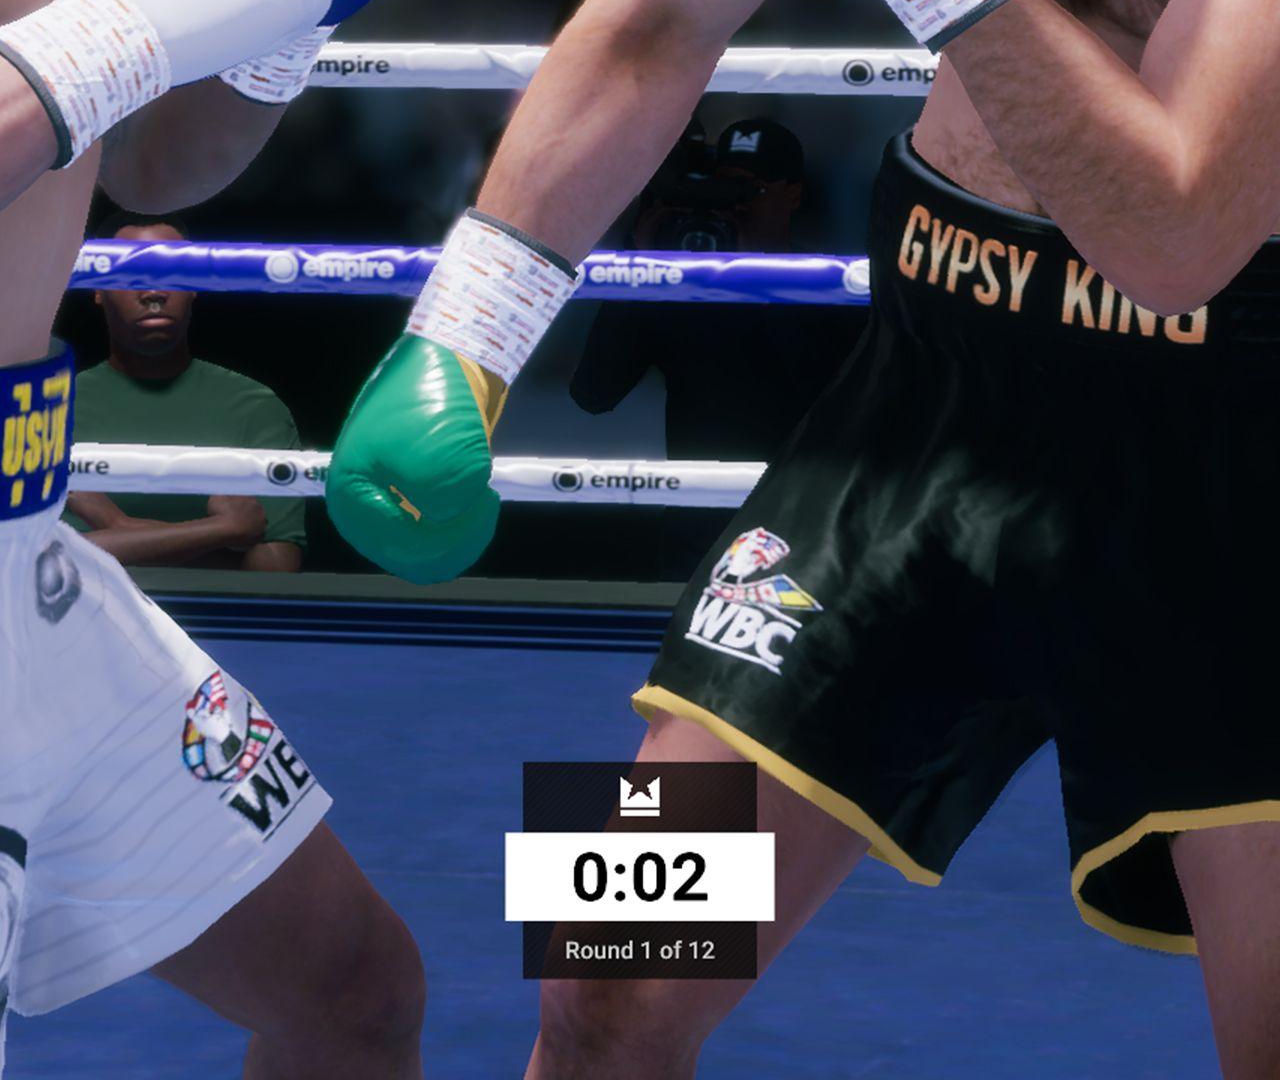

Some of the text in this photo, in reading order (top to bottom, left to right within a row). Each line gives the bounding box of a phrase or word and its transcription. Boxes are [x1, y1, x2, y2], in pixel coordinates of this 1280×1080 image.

[314, 55, 389, 77] mpire
[882, 65, 936, 85] emp
[73, 252, 112, 274] ire
[302, 255, 394, 281] empire
[898, 204, 1038, 312] GYPSY
[591, 263, 682, 288] empire
[2, 402, 67, 477] USYK
[591, 470, 680, 492] empire
[690, 593, 797, 666] WBC
